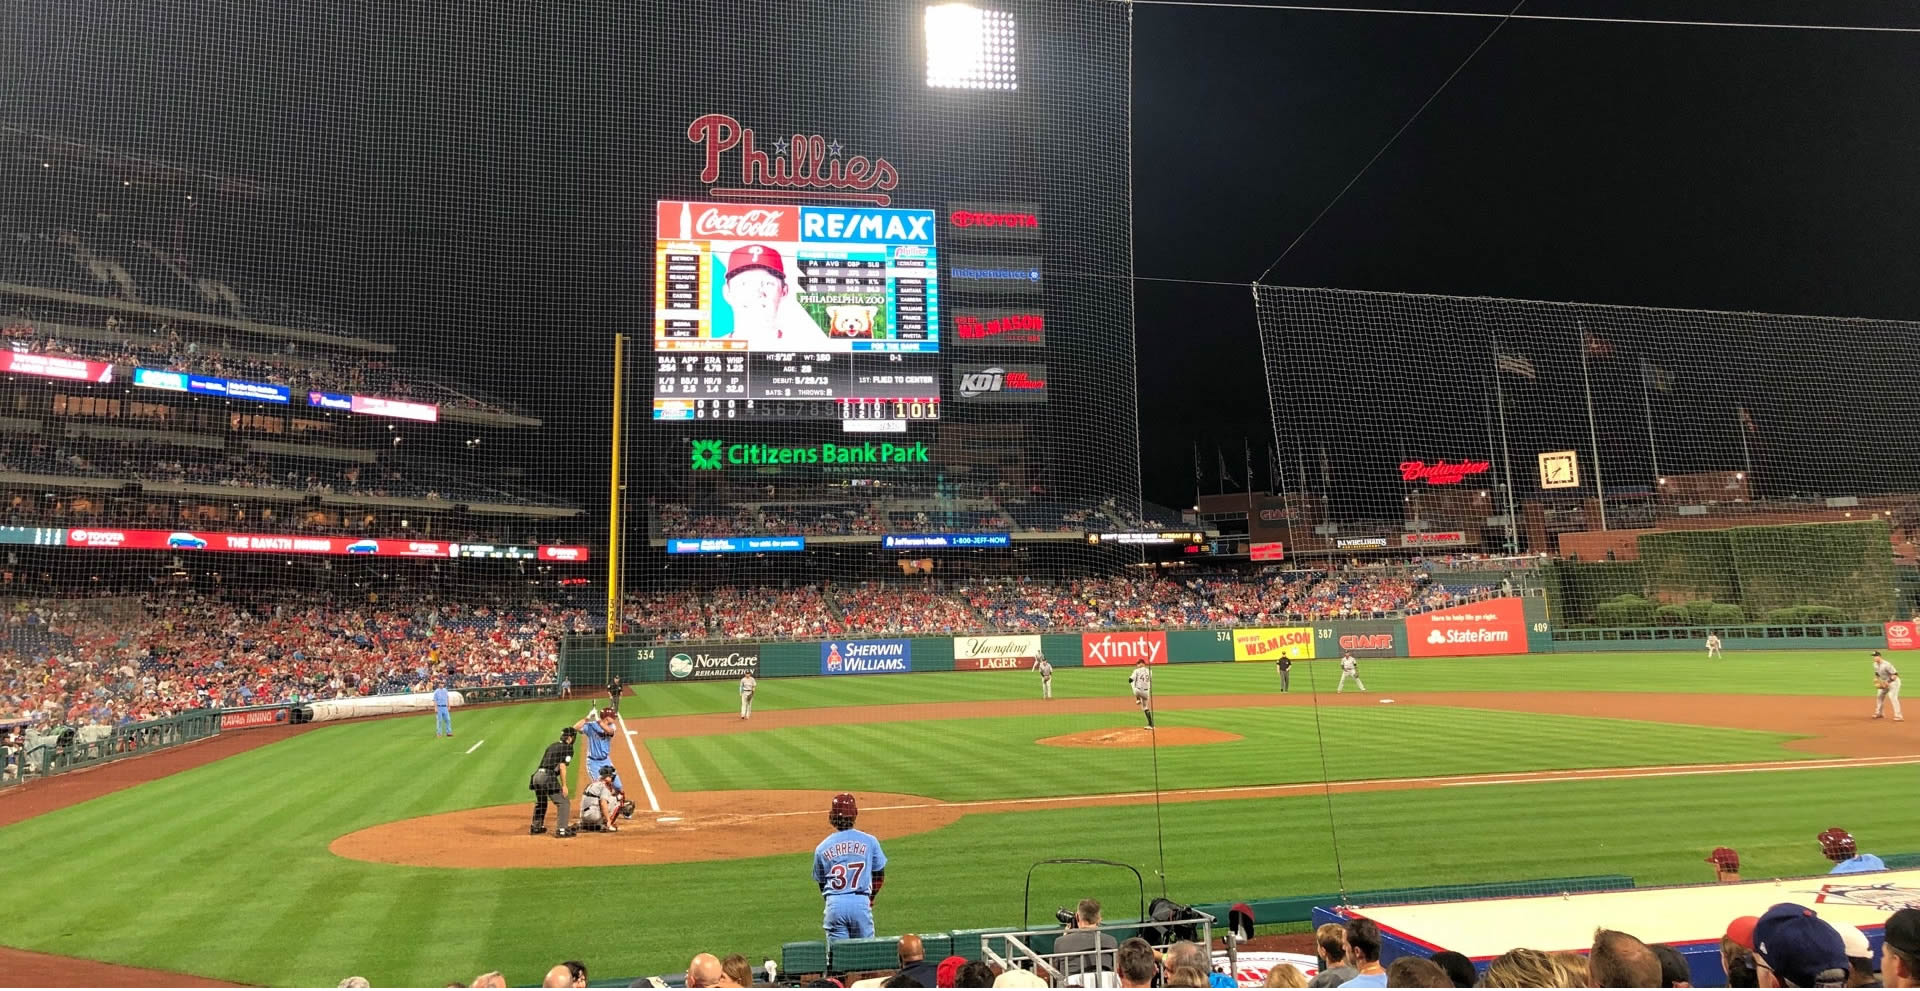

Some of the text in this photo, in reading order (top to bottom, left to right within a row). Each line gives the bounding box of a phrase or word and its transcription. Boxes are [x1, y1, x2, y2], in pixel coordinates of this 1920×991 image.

[687, 114, 899, 191] Phillies
[804, 212, 929, 240] RE/MAX
[972, 213, 1038, 228] TOYOTA
[951, 267, 1025, 280] Independence
[800, 294, 885, 304] PHILADELPHIA ZOO
[658, 356, 676, 364] BAA
[889, 353, 903, 361] 0-1
[773, 377, 794, 385] DEBUT:
[873, 376, 893, 384] FLIED
[894, 376, 904, 384] TO
[905, 376, 934, 384] CENTER
[959, 373, 1004, 392] KDI
[697, 400, 704, 408] 0
[712, 400, 719, 408] 0
[728, 400, 735, 408] 0
[747, 400, 754, 408] 2
[896, 403, 937, 418] 1 0 1
[697, 410, 704, 418] 0
[712, 410, 719, 418] 0
[728, 410, 735, 418] 0
[859, 410, 864, 418] 2
[874, 410, 880, 418] 0
[728, 442, 929, 464] Citizens Bank Park
[1399, 459, 1490, 481] Budweiser
[87, 531, 125, 542] TOYOTA
[227, 536, 249, 548] THE
[1533, 622, 1548, 632] 409
[1216, 631, 1231, 641] 374
[1318, 629, 1333, 639] 387
[966, 640, 1029, 656] Yuengling
[1339, 634, 1391, 650] GIANT
[637, 650, 655, 660] 334
[845, 643, 903, 656] SHERWIN
[1089, 635, 1161, 664] xfinity
[694, 653, 757, 668] NovaCare
[979, 657, 1017, 669] LAGER
[246, 711, 272, 724] INNING
[823, 841, 868, 861] HERRERA
[831, 861, 865, 890] 37
